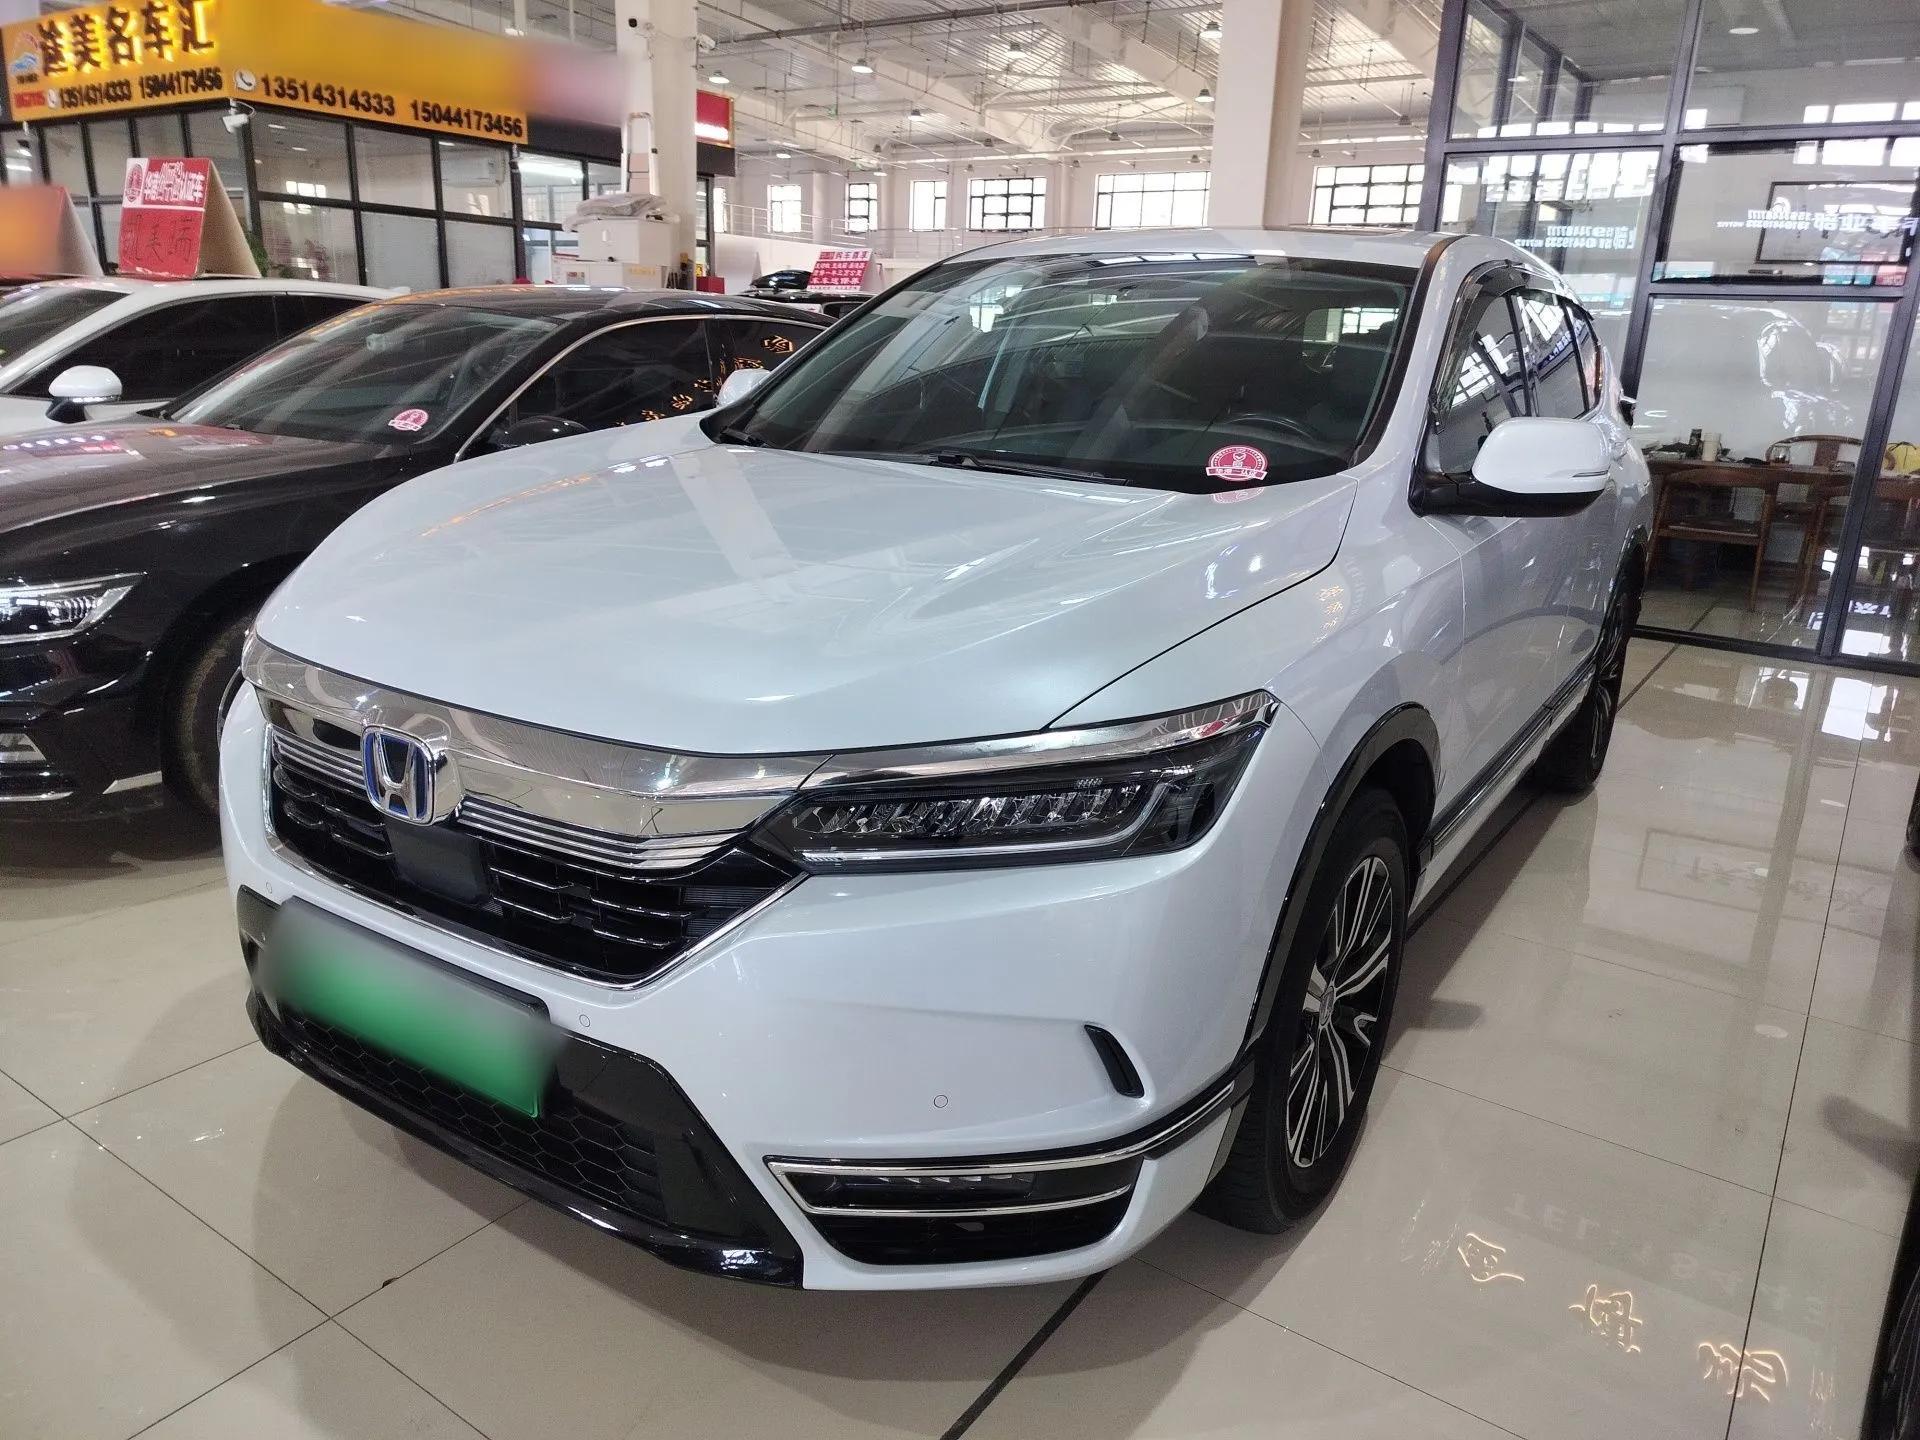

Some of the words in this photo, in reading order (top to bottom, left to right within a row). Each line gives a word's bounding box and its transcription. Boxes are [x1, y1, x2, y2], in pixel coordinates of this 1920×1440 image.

[139, 67, 222, 99] 15044173456
[261, 74, 395, 116] 13514314333
[410, 99, 523, 138] 15044173456
